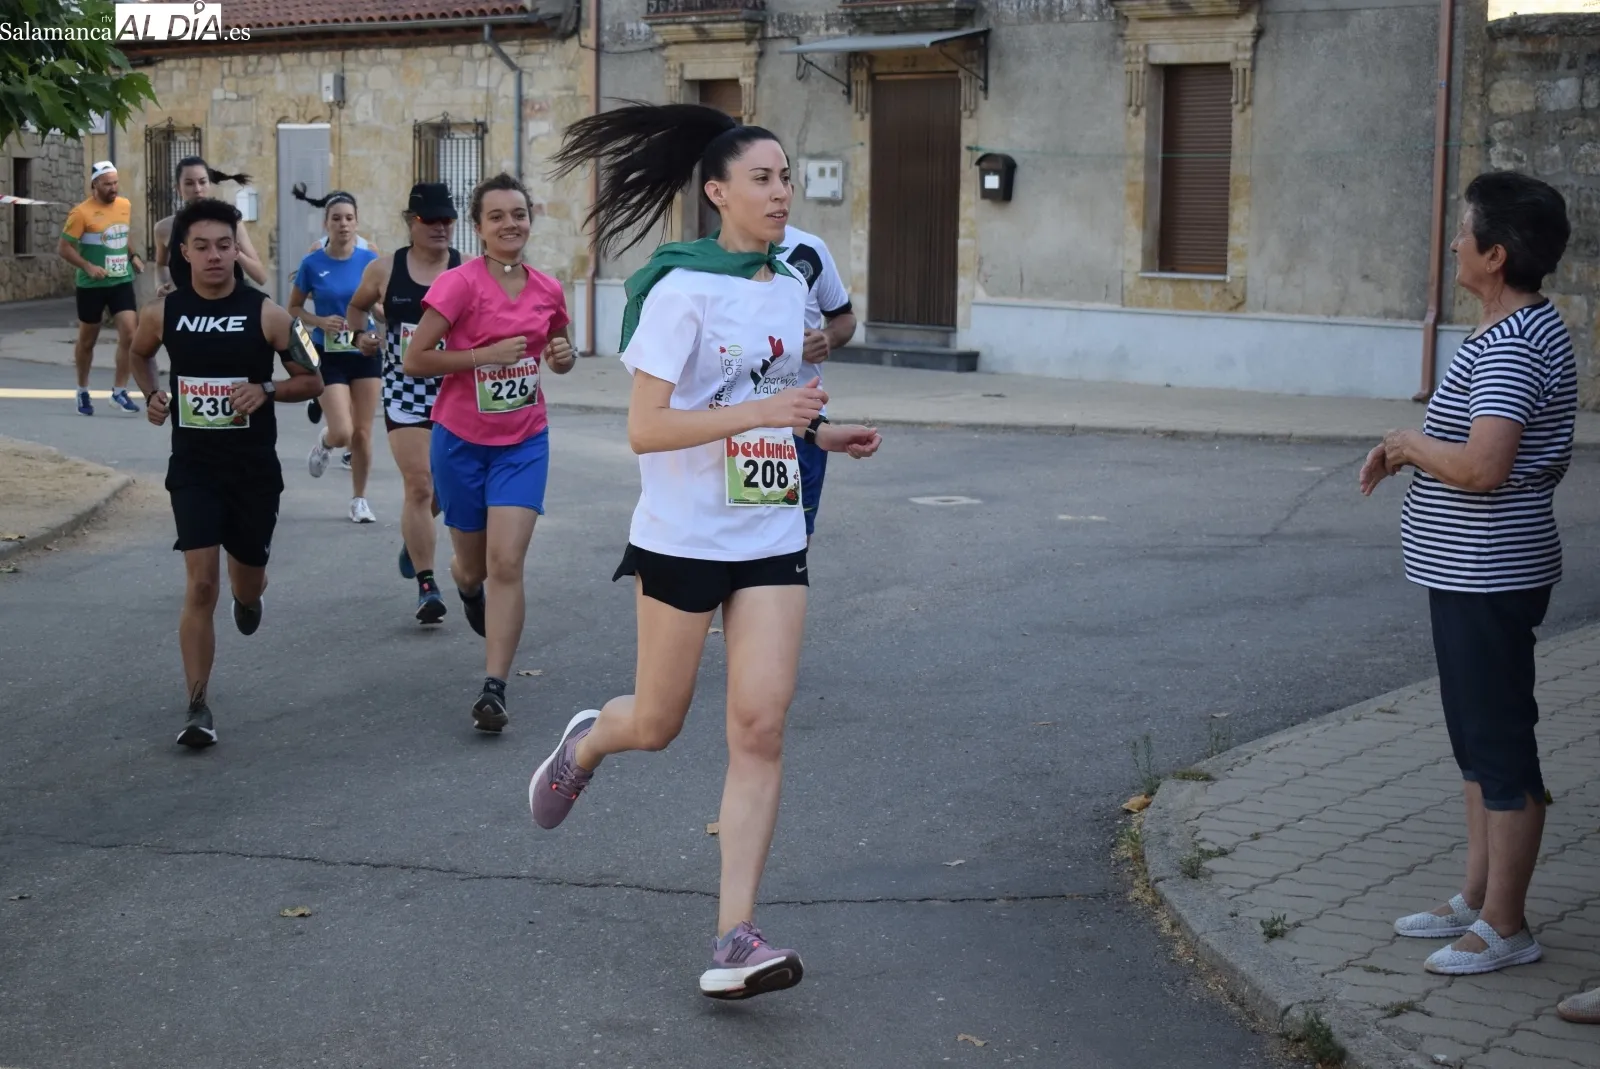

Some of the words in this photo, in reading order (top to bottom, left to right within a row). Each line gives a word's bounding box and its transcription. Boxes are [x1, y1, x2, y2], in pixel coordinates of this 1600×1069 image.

[176, 315, 248, 333] NIKE
[333, 332, 350, 344] 21
[476, 360, 538, 383] bedunia
[180, 380, 236, 397] bedun
[491, 378, 529, 401] 226
[192, 397, 234, 416] 230
[726, 436, 797, 461] bedunia
[743, 459, 789, 489] 208
